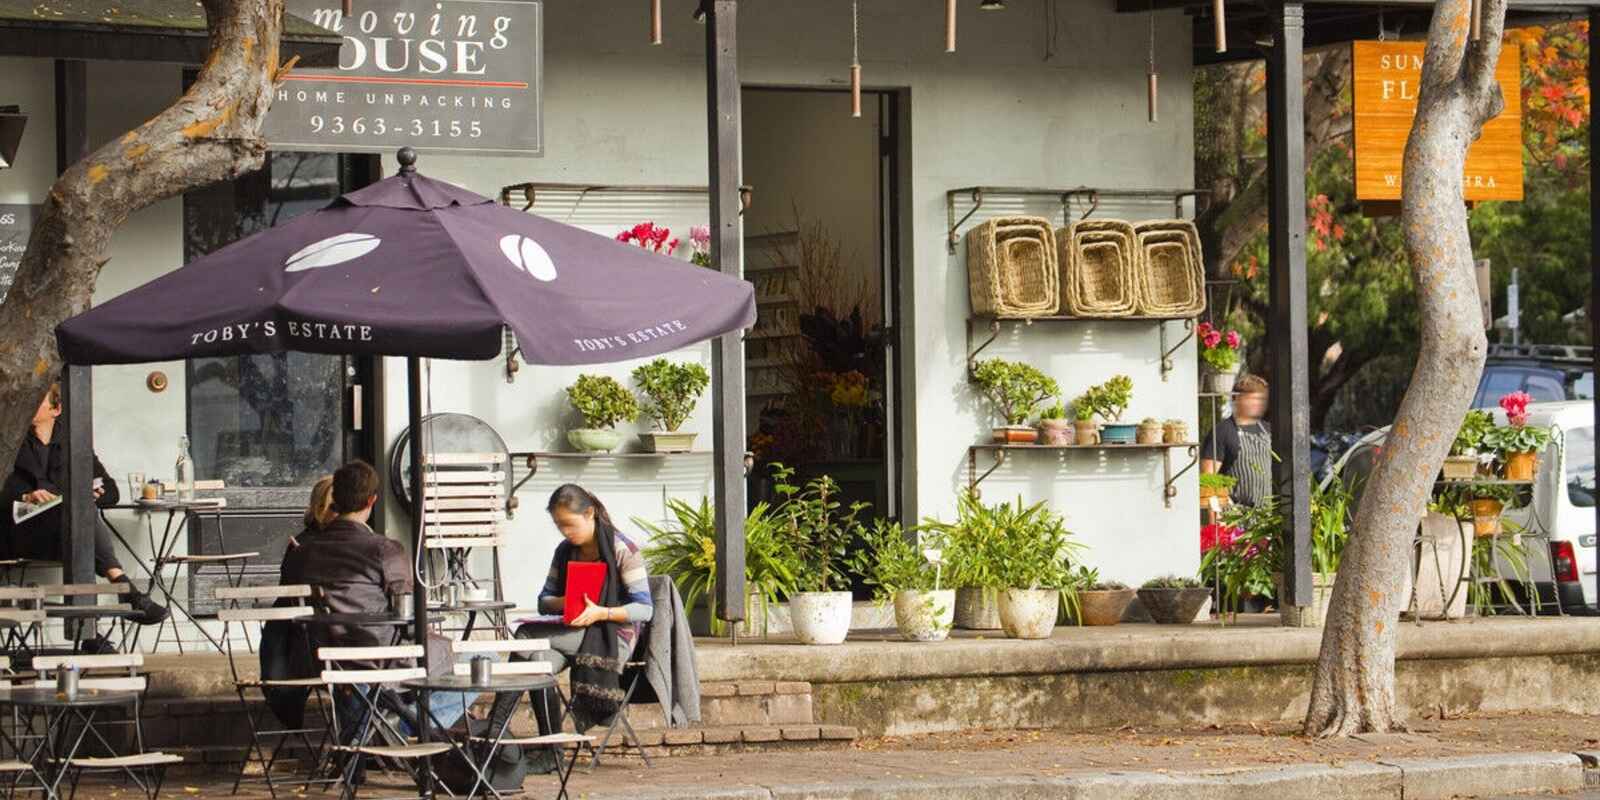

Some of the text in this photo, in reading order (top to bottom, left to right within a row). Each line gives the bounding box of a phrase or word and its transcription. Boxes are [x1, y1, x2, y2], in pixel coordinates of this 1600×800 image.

[313, 3, 511, 49] moving
[338, 36, 487, 75] OUSE
[278, 90, 512, 109] HOME UNPACKING
[310, 115, 482, 138] 9363-3155
[191, 320, 373, 345] TOBY'S ESTATE
[573, 319, 687, 352] TOBY'S ESTATE
